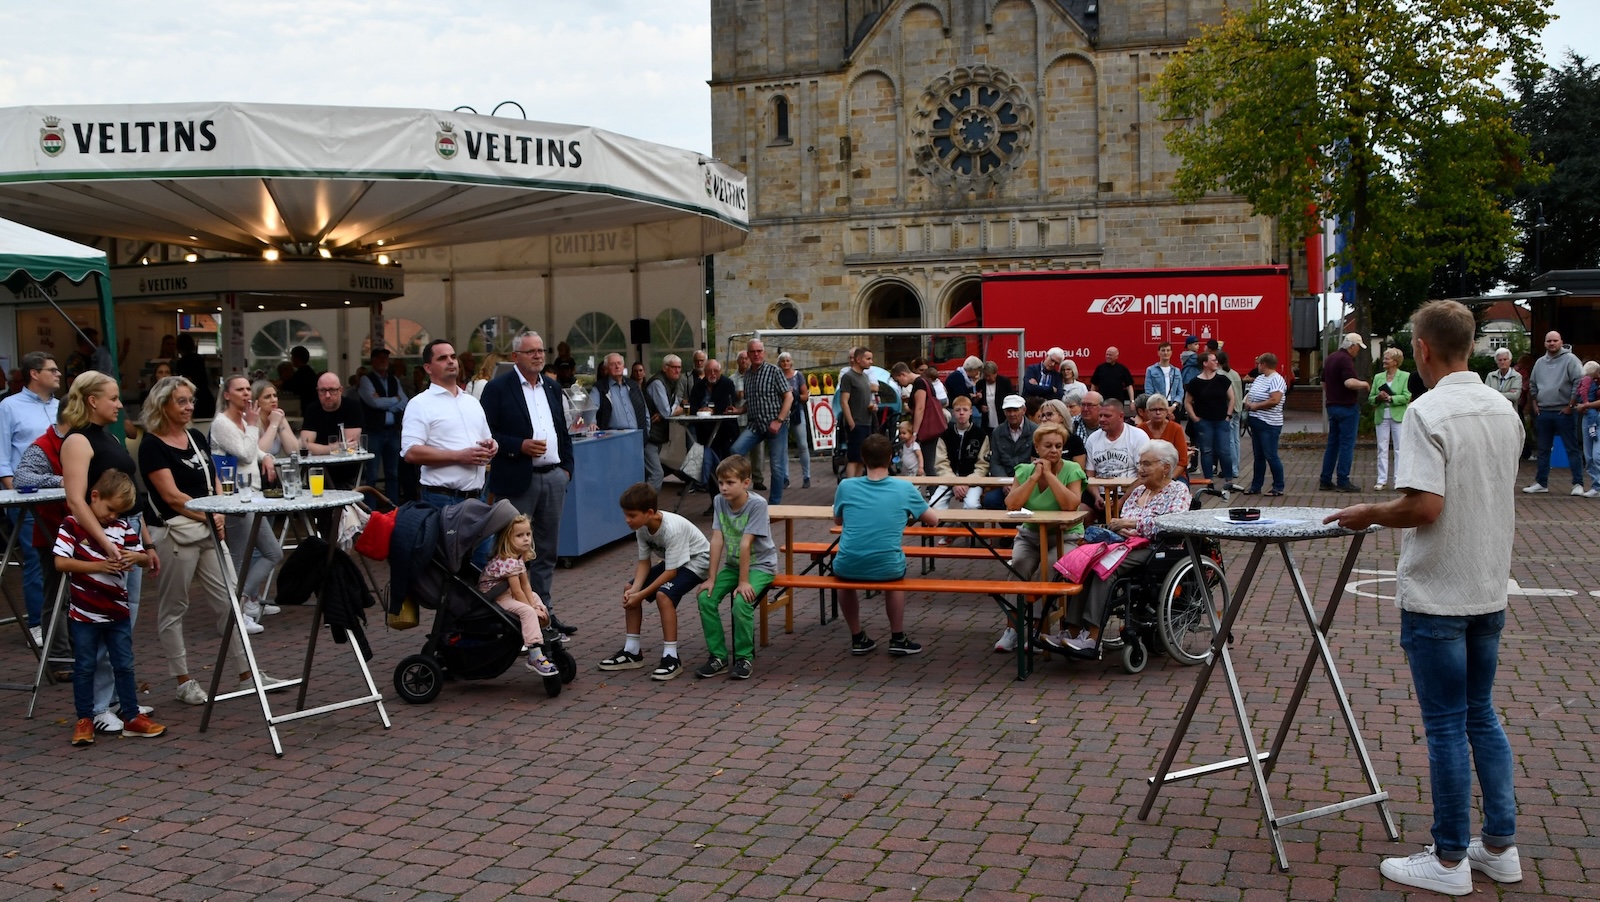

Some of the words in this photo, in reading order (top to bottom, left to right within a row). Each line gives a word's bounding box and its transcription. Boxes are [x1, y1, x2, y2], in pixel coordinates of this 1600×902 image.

[72, 120, 217, 154] VELTINS
[464, 130, 582, 168] VELTINS
[713, 174, 746, 211] VELTINS
[147, 277, 188, 291] VELTINS
[358, 276, 394, 290] VELTINS
[1144, 293, 1218, 314] NIEMANN
[1224, 298, 1254, 308] GMBH
[1075, 347, 1090, 358] 4.0
